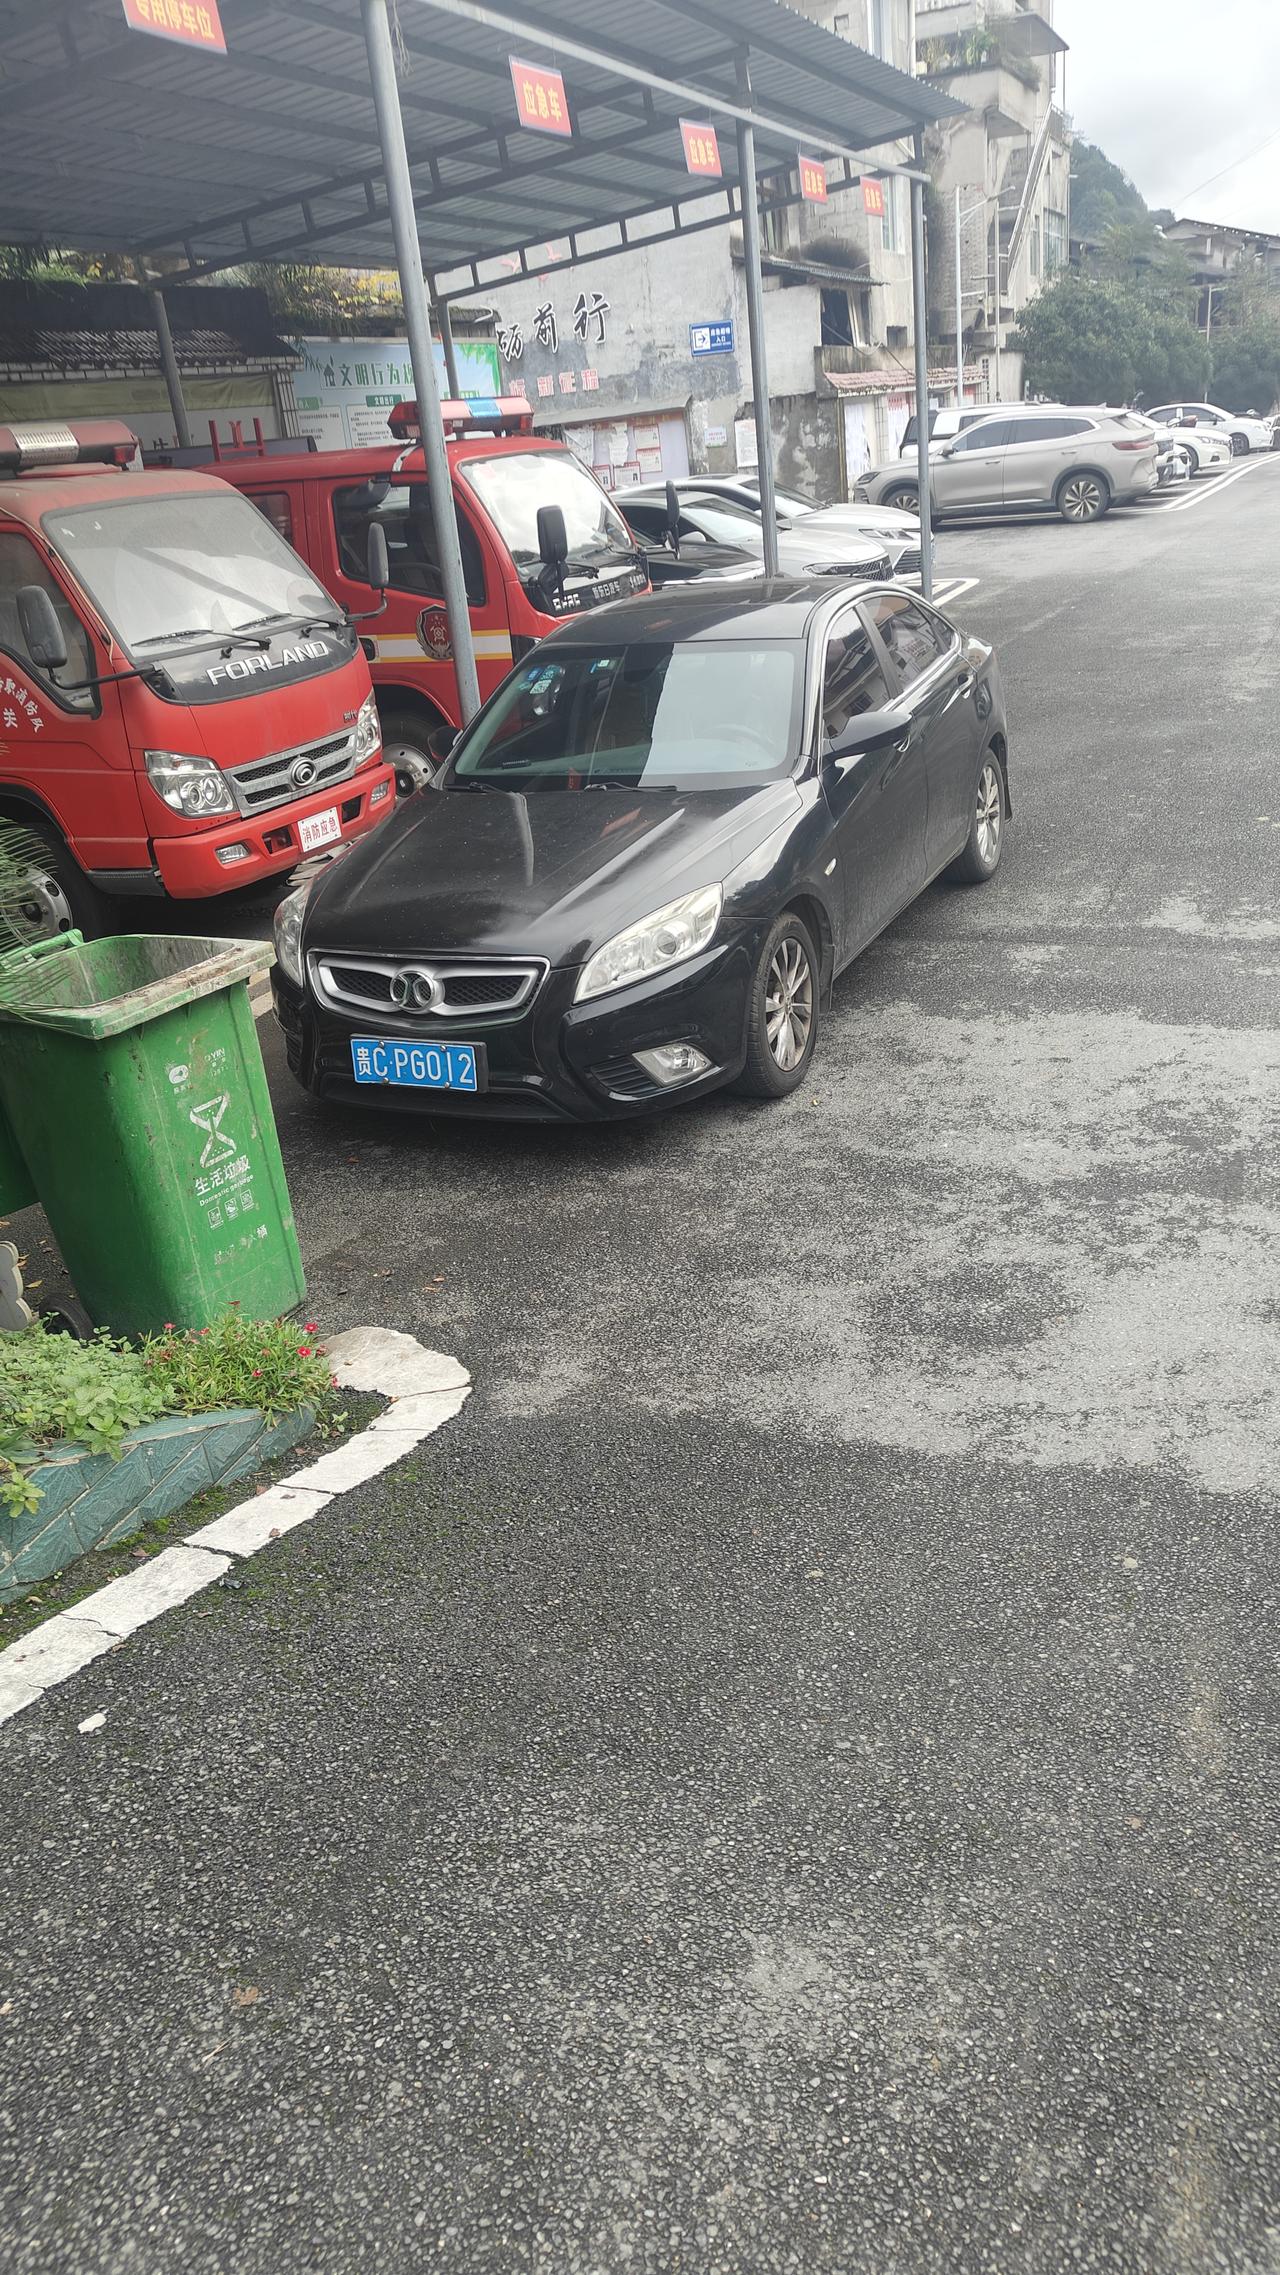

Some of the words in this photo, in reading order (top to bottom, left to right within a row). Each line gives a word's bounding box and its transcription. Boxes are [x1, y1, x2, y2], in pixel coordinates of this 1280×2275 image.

[522, 80, 562, 122] 应急车
[688, 136, 716, 167] 应急车
[205, 640, 329, 686] FORLAND
[302, 816, 338, 844] 消防应急
[194, 1154, 251, 1196] 生活垃圾
[199, 1187, 230, 1207] Domestic
